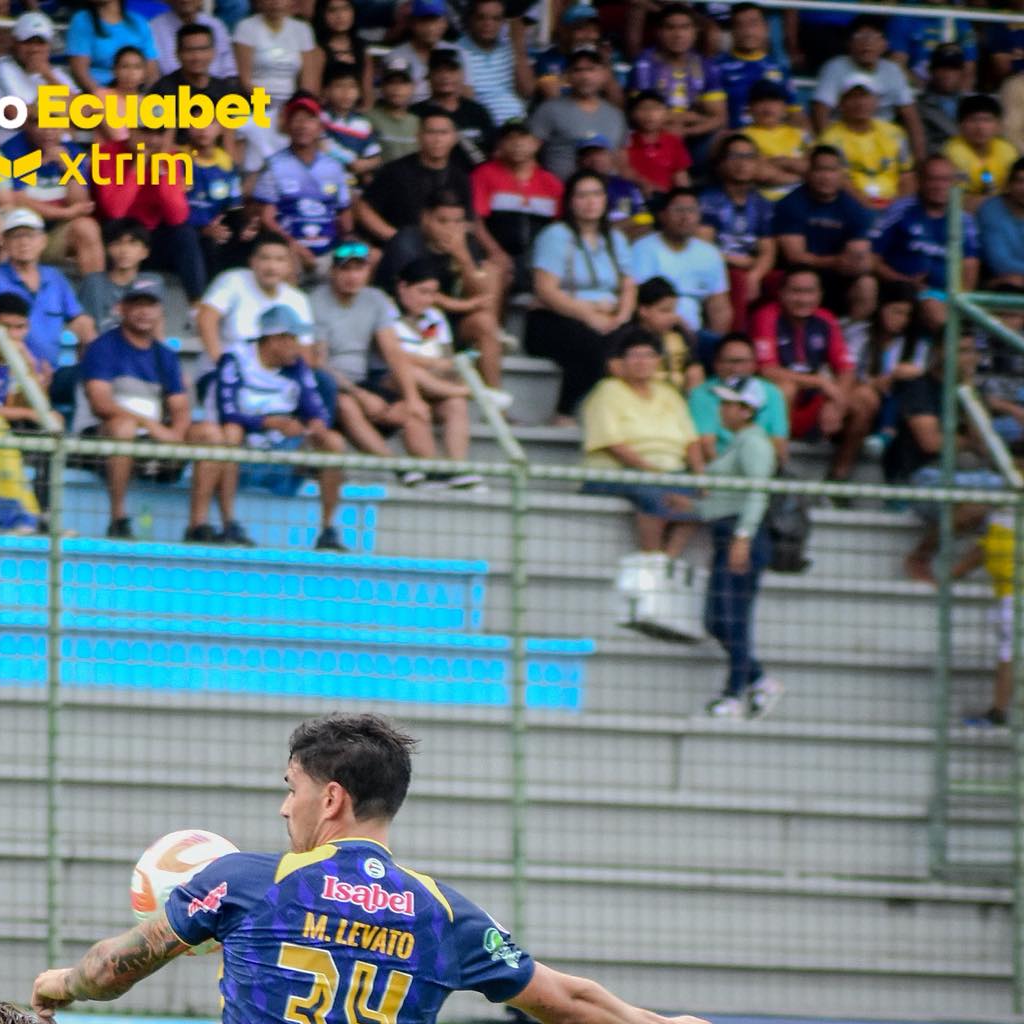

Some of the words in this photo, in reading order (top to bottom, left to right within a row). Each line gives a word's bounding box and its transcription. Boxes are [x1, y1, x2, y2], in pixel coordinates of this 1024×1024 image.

[321, 876, 415, 916] Isabel
[302, 912, 331, 942] M.
[335, 918, 415, 960] LEVATO
